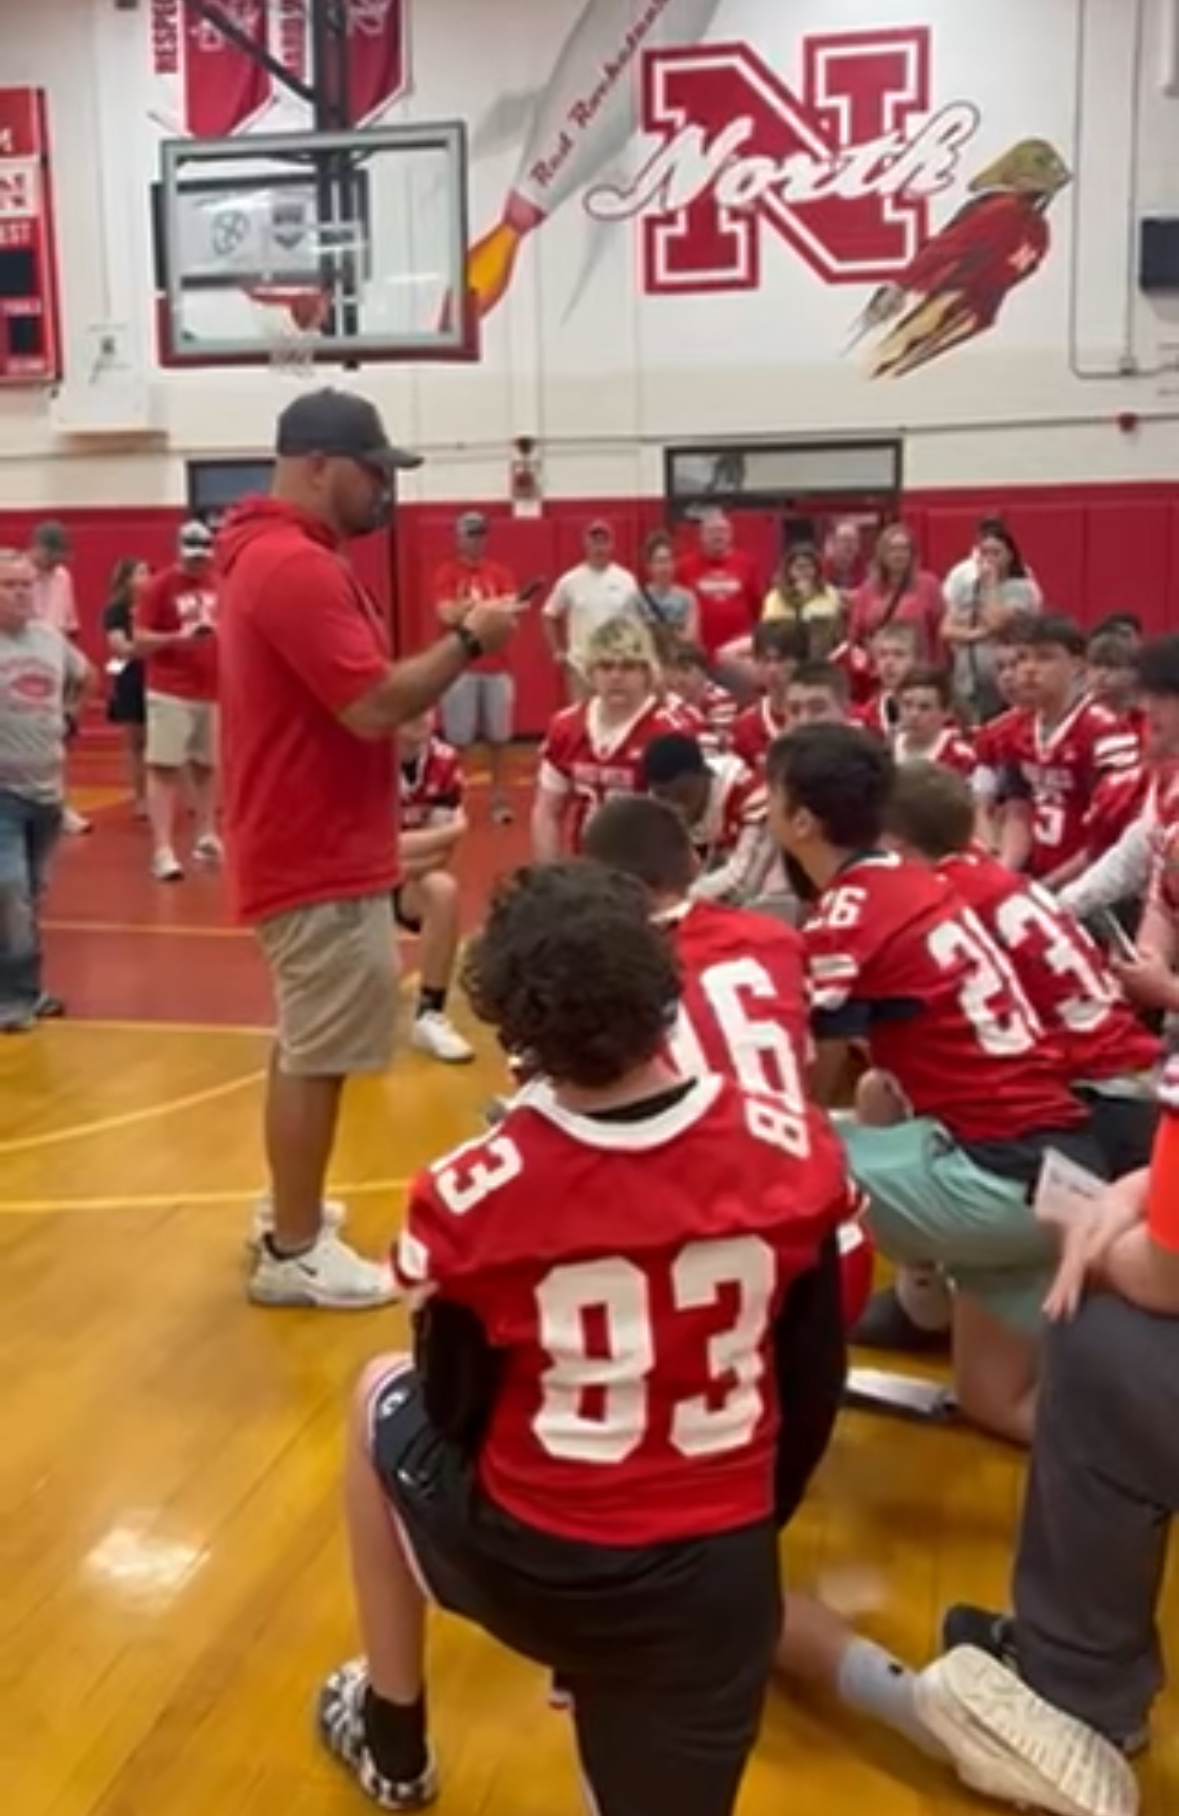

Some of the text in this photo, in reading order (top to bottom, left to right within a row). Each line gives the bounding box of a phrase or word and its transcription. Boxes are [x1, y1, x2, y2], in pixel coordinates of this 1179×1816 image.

[583, 100, 981, 221] North
[643, 26, 931, 294] N
[530, 1232, 778, 1464] 83
